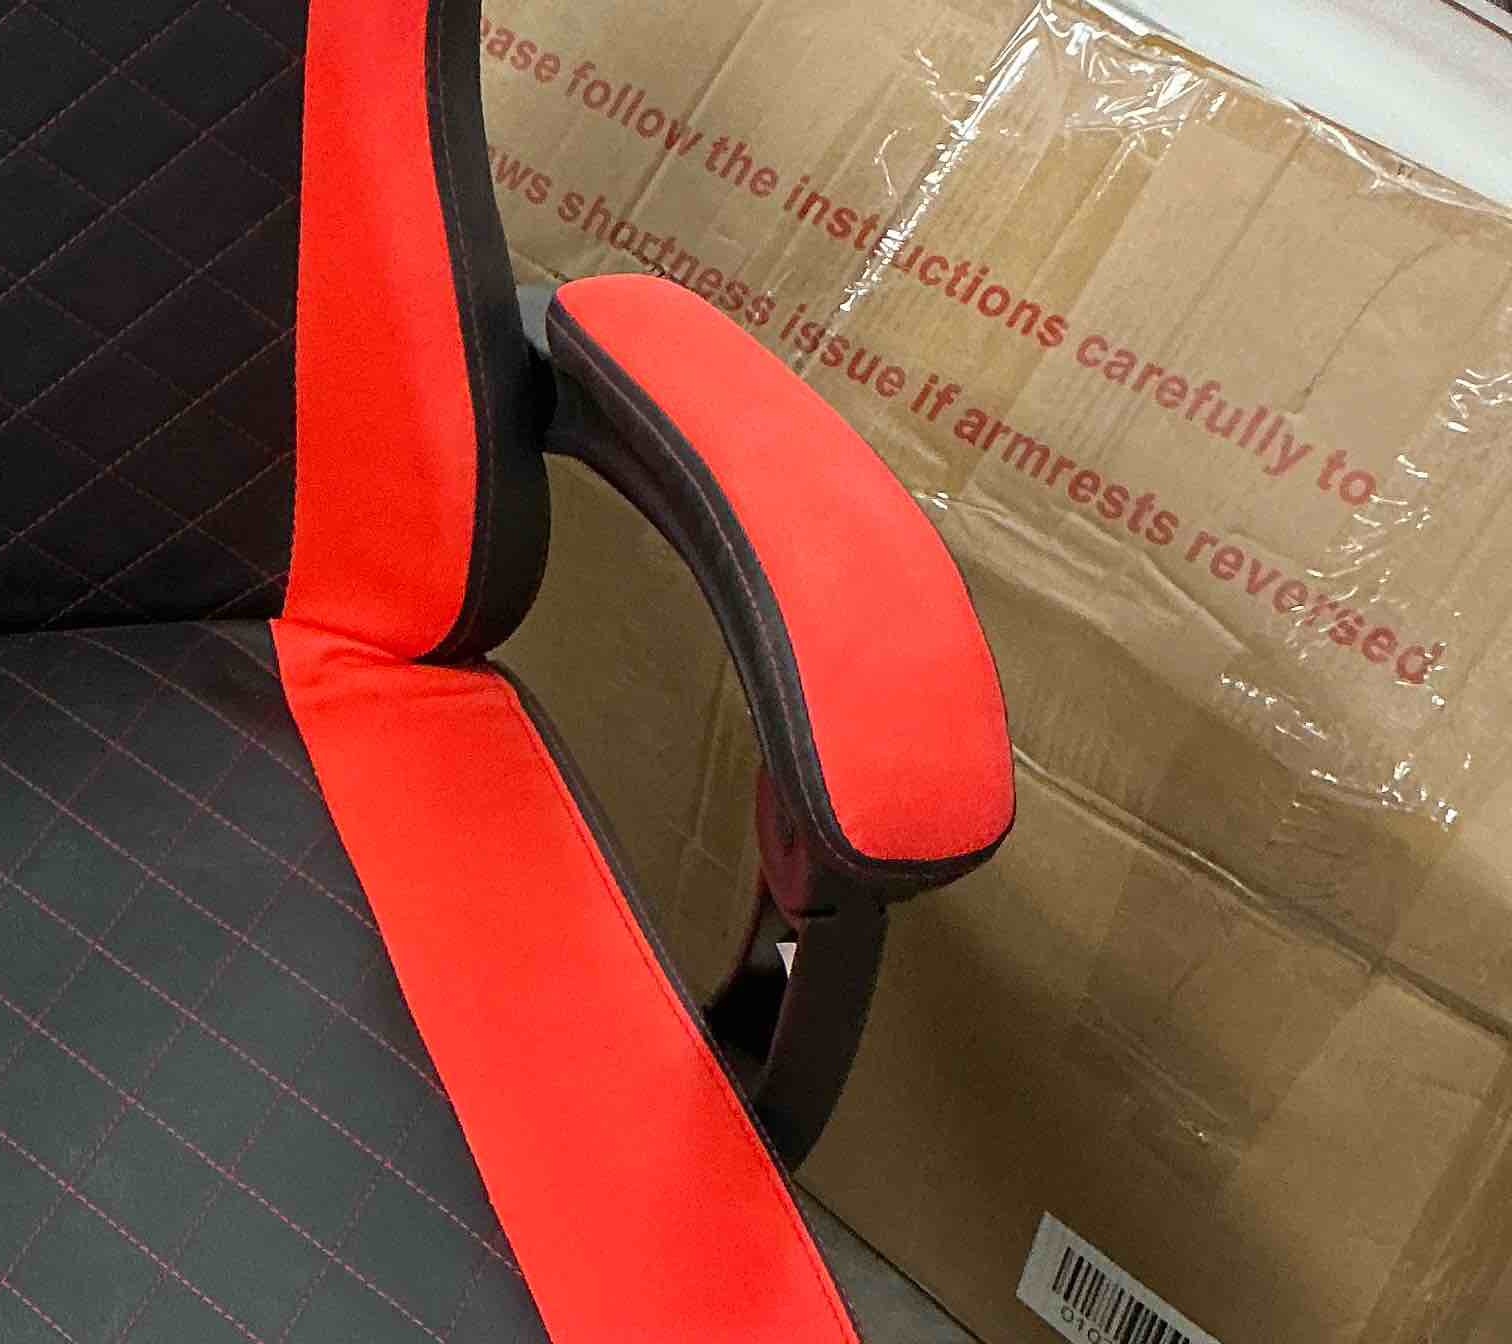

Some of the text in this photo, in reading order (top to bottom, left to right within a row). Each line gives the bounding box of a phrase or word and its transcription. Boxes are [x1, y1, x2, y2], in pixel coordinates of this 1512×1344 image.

[488, 144, 1448, 686] ws shortness issue if armrests reversed
[564, 60, 704, 156] follow
[703, 134, 779, 198] the
[783, 174, 1071, 349] instuctions
[1074, 333, 1314, 477] carefully
[1316, 447, 1379, 508] to
